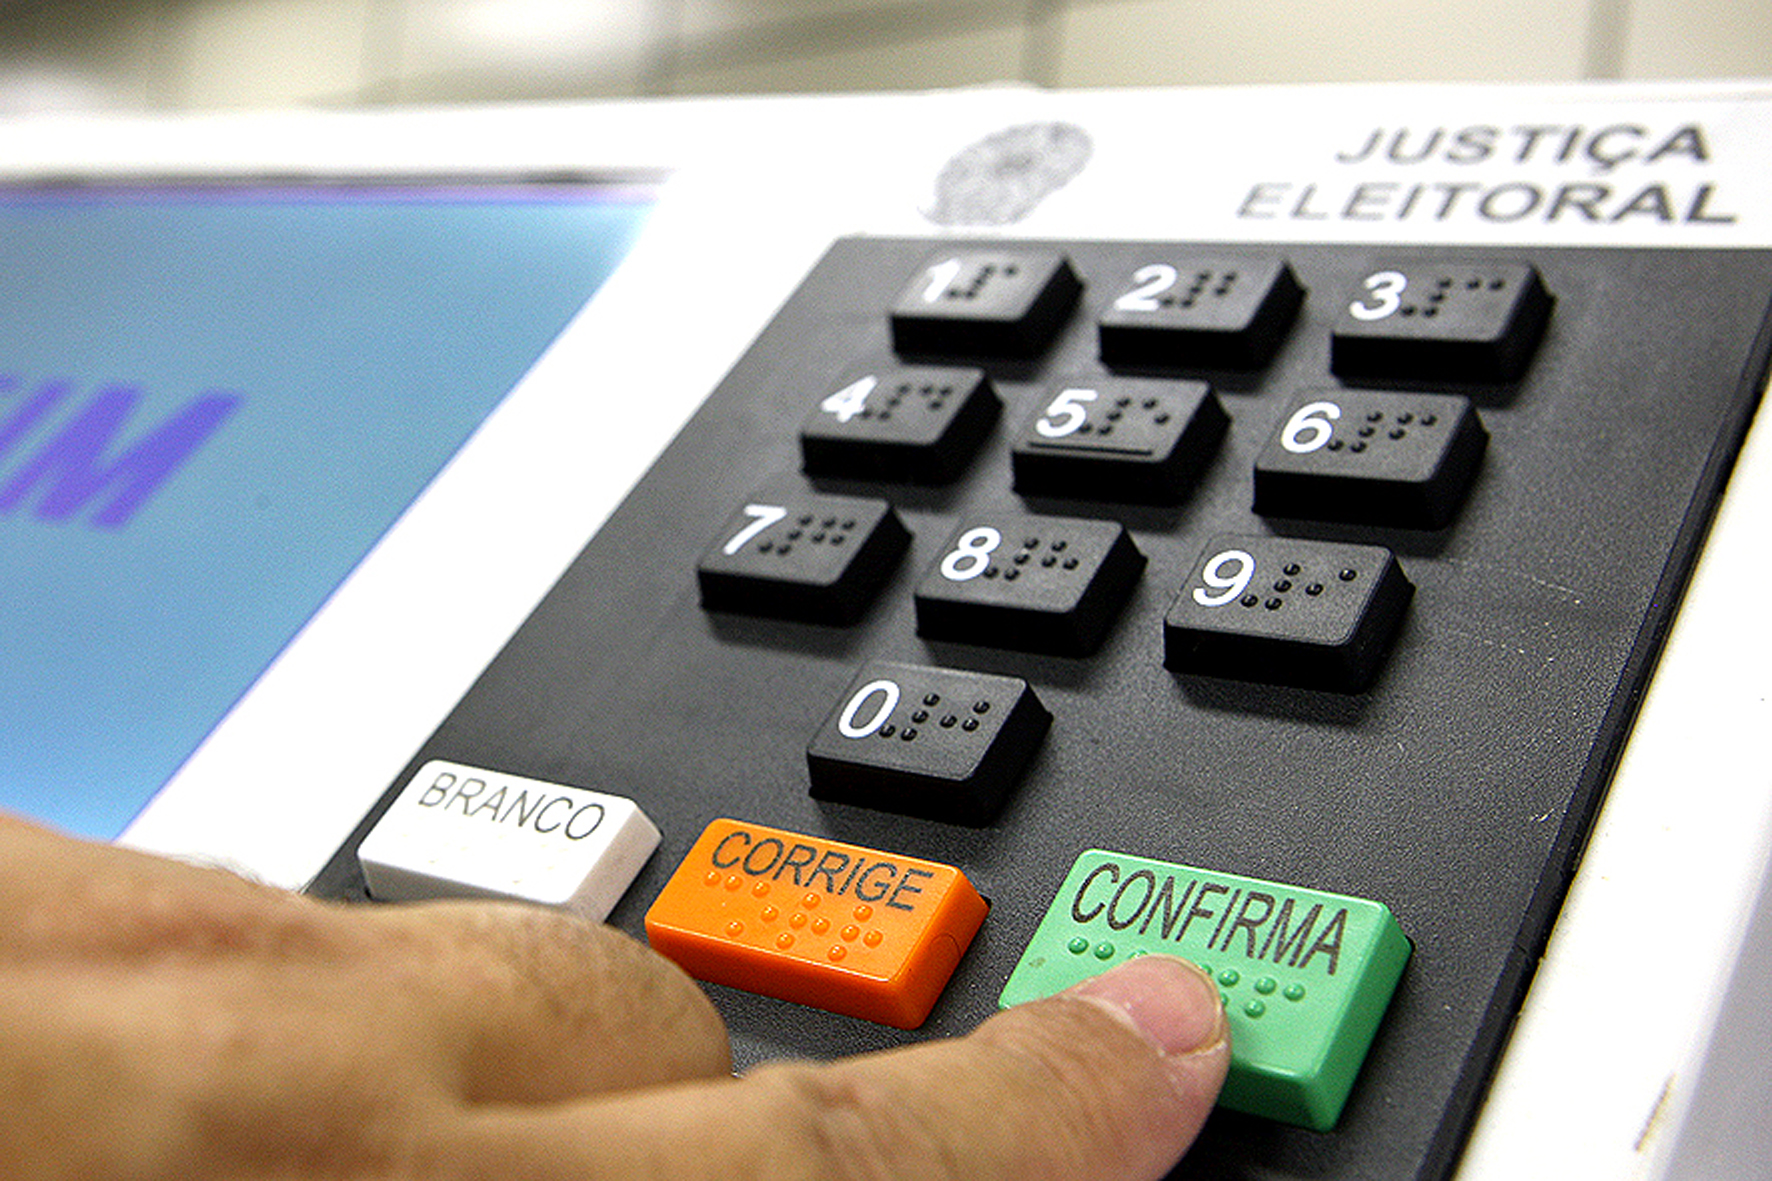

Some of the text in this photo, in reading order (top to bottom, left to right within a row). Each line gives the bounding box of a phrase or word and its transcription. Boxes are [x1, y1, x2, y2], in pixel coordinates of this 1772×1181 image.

[1334, 122, 1711, 175] JUSTIÇA
[1236, 182, 1738, 224] ELEITORAL
[923, 258, 961, 302] 1
[1115, 264, 1178, 311] 2
[1349, 271, 1407, 320] 3
[821, 375, 877, 422] 4
[1036, 388, 1098, 437] 5
[1280, 402, 1341, 453] 6
[723, 504, 787, 555] 7
[940, 526, 1001, 581] 8
[1192, 550, 1256, 607] 9
[838, 680, 900, 739] 0
[417, 772, 605, 841] BRANCO
[711, 831, 934, 912] CORRIGE
[1070, 862, 1349, 976] CONFIRMA
